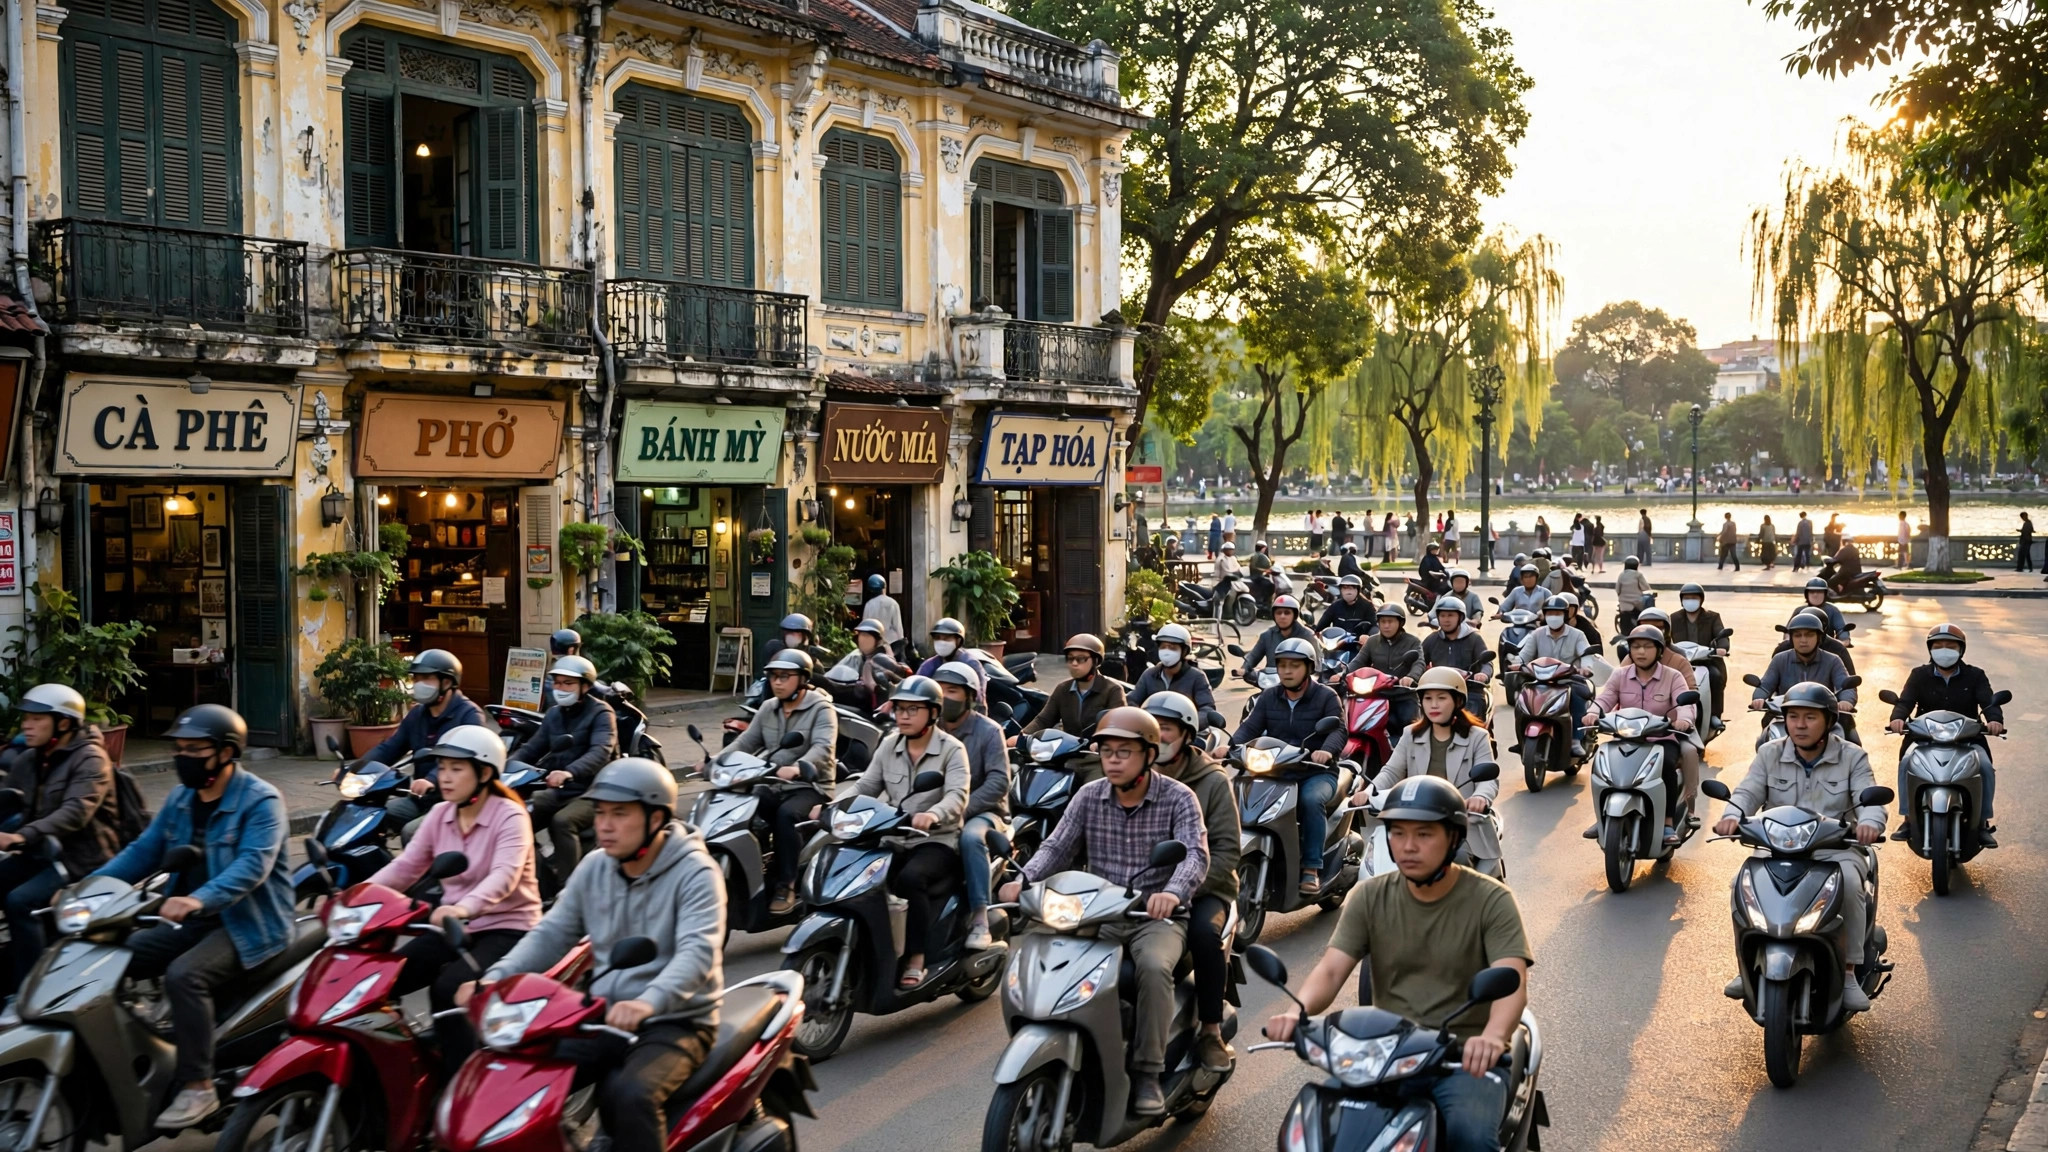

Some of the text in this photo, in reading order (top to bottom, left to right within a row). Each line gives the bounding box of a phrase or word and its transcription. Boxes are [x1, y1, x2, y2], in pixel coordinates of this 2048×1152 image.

[94, 394, 268, 452] CÀ PHÊ
[414, 408, 517, 459] PHỞ
[638, 416, 767, 463] BÁNH MỲ
[833, 418, 938, 464] NƯỚC MÍA
[1001, 425, 1096, 474] TẠP HÓA
